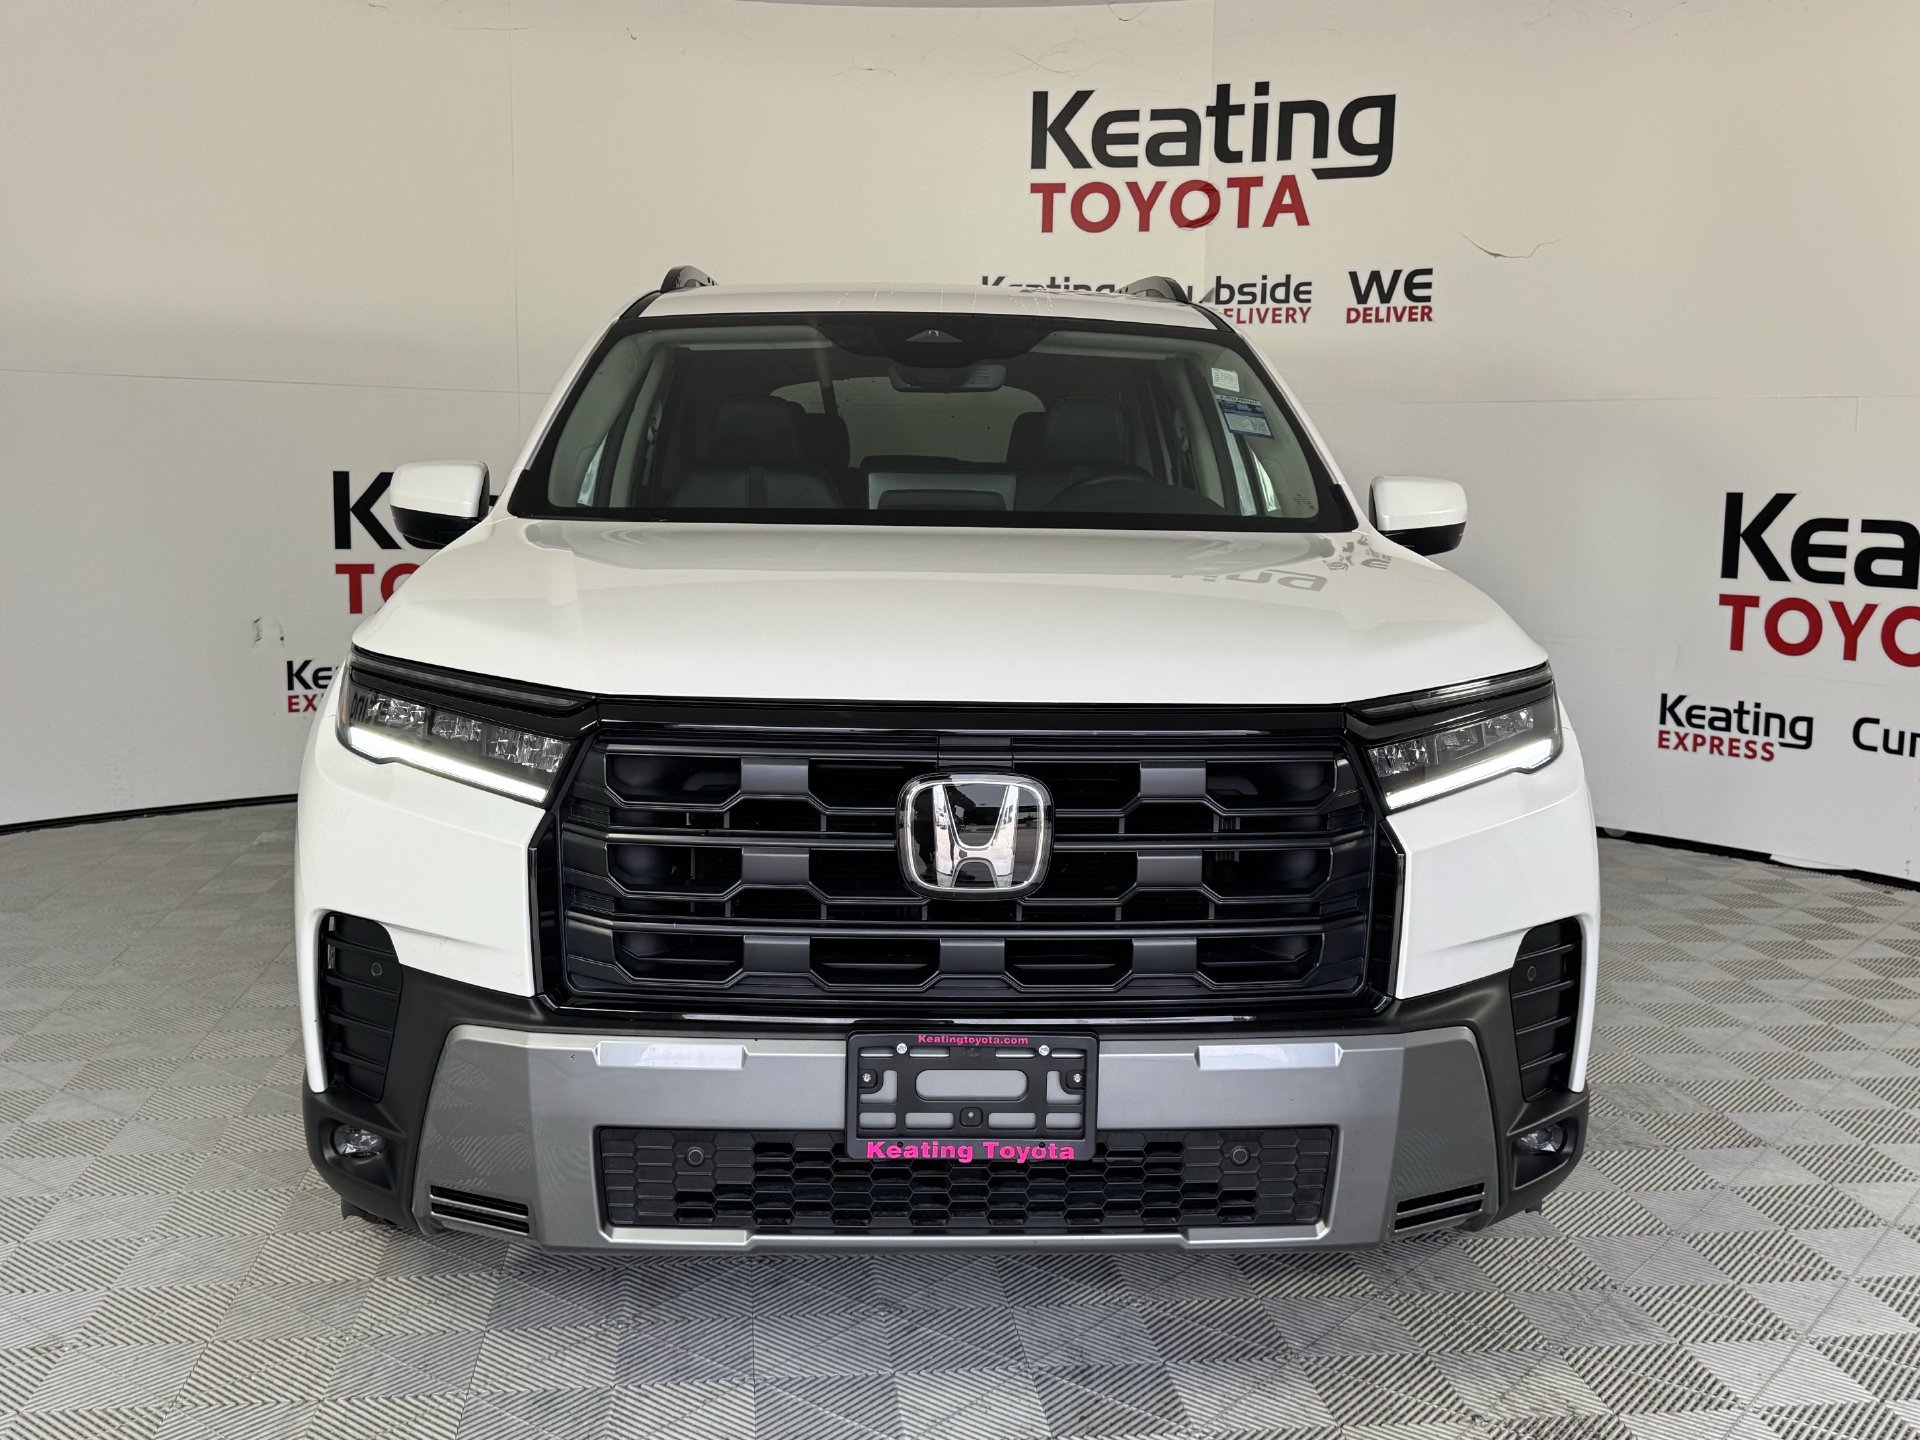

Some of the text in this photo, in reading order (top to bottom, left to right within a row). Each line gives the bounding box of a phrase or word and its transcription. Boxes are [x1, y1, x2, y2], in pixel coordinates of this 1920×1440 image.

[1030, 81, 1397, 180] Keating
[1030, 174, 1310, 234] TOYOTA
[1187, 274, 1313, 305] bside
[1348, 268, 1434, 305] WE
[1223, 306, 1312, 324] ELIVERY
[1345, 305, 1434, 324] DELIVER
[1658, 693, 1814, 750] Keating
[1657, 729, 1775, 762] EXPRESS
[918, 1034, 1028, 1045] Keatingtoyota.com
[866, 1141, 1075, 1163] Keating Toyota
